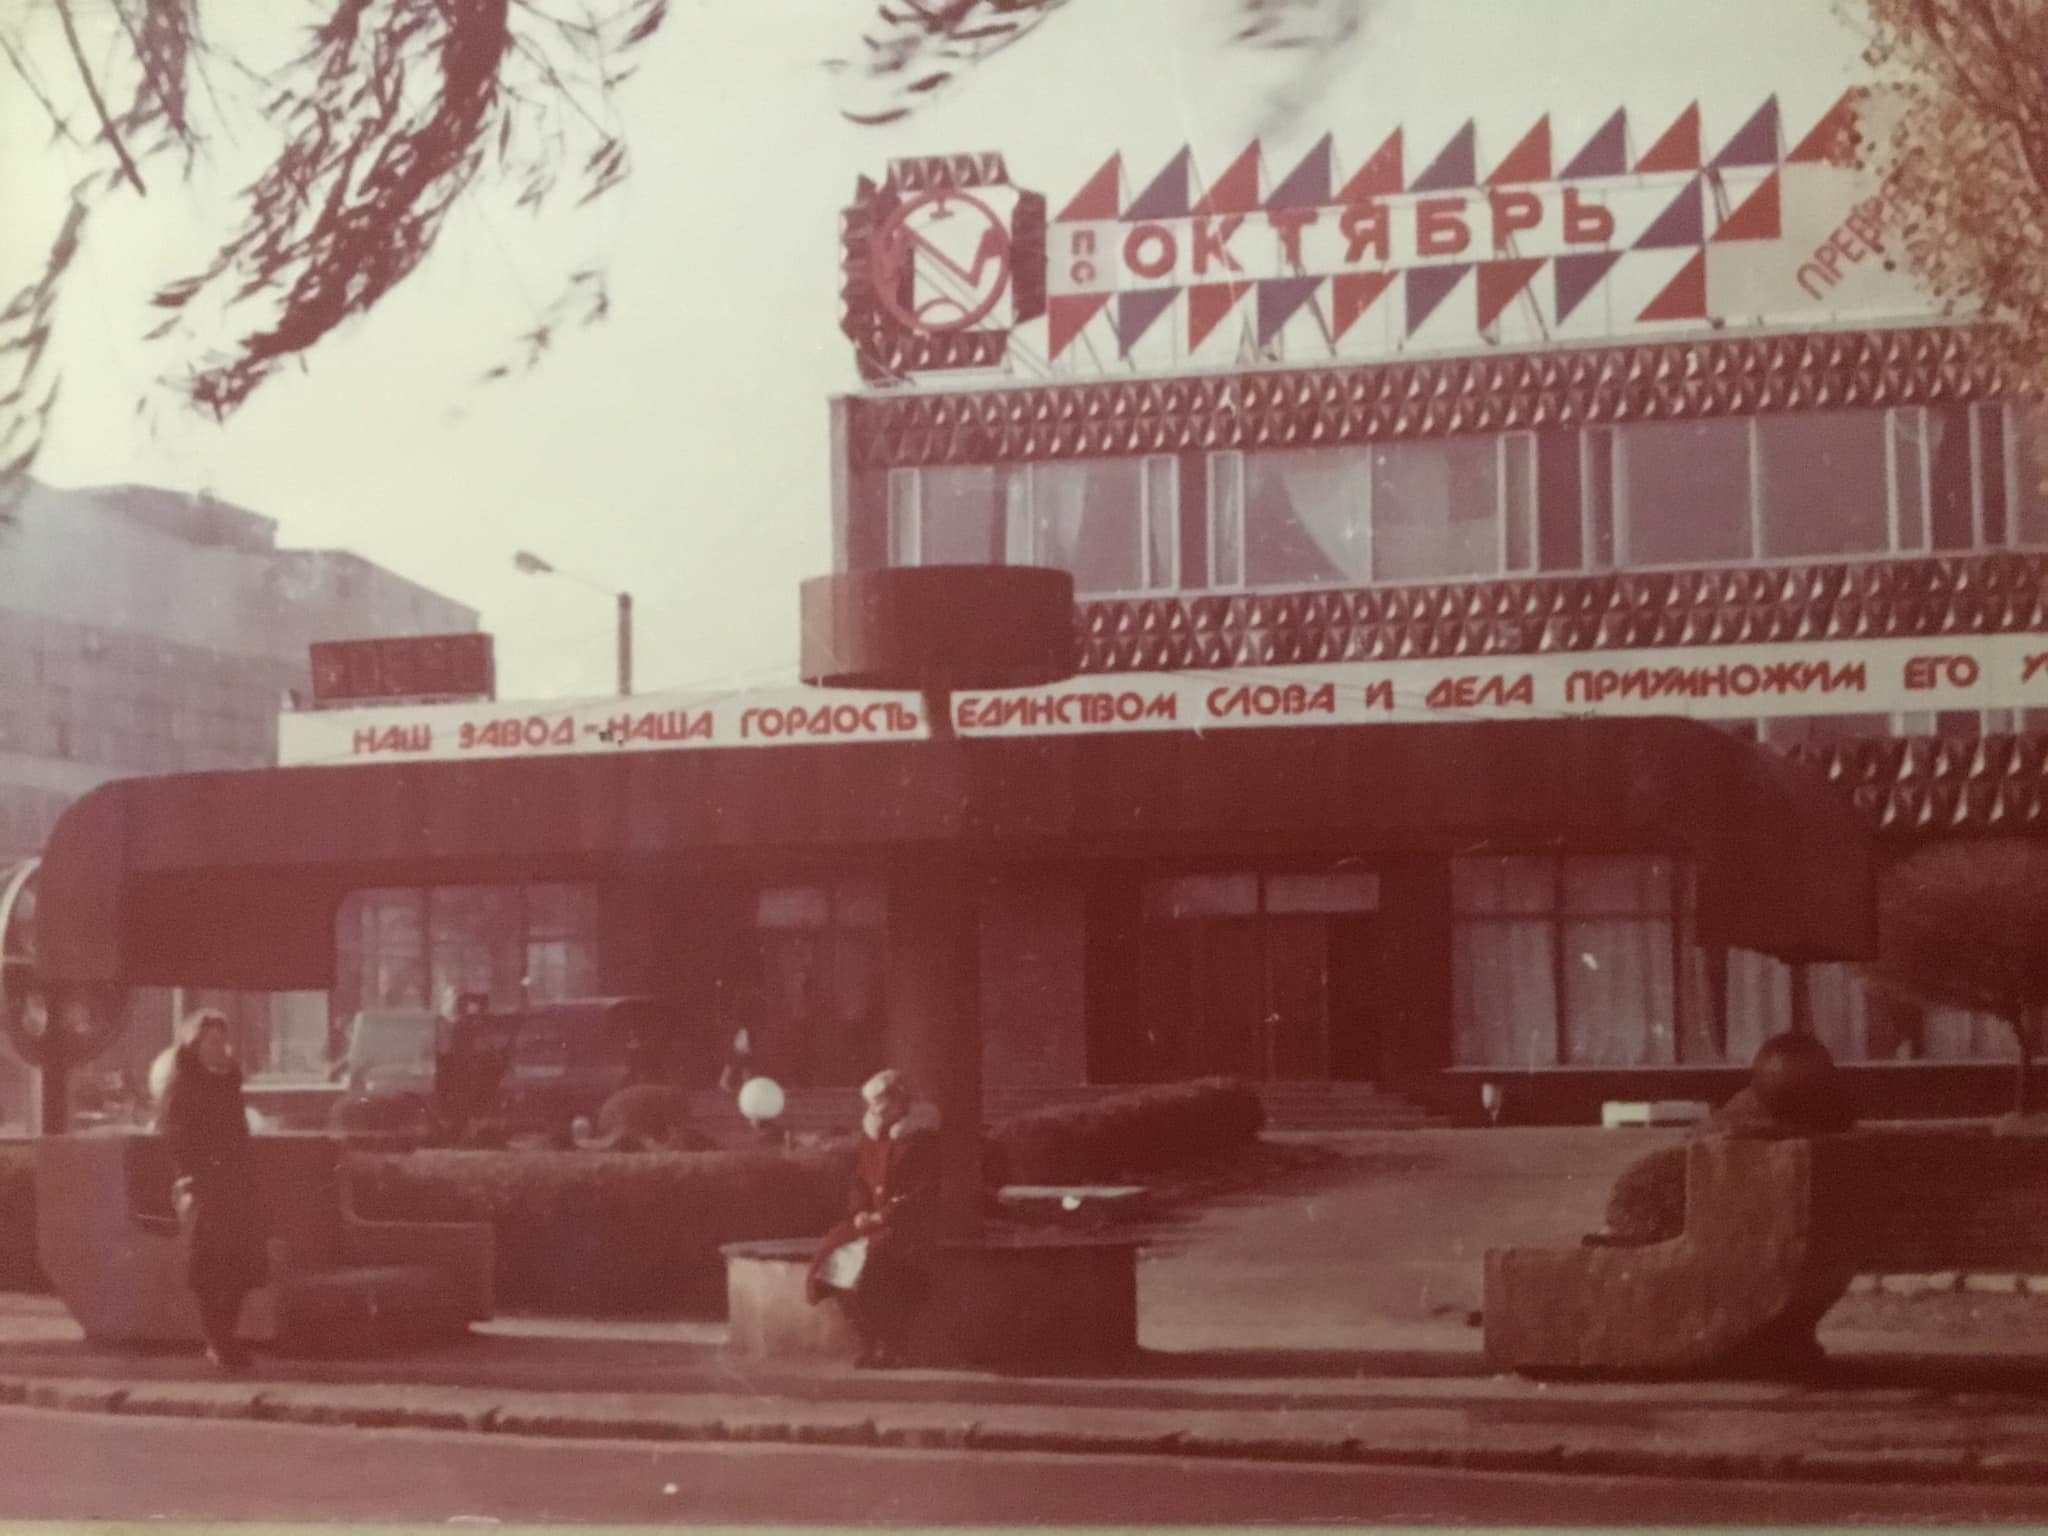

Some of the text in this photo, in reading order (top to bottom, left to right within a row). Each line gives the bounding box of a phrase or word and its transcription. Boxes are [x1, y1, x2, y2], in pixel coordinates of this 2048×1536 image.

[1121, 187, 1615, 280] ОКТЯБРЬ
[353, 725, 431, 755] НАШ
[740, 701, 918, 740] ГОРДОСТЬ
[956, 691, 1178, 730] ЕДИНСТВОМ
[1206, 682, 1336, 719] СЛОВА
[1364, 680, 1395, 711] И
[1424, 672, 1535, 709] ДЕЛА
[1565, 659, 1867, 704] ПРИУМНОЖИМ
[1904, 654, 1979, 691] ЕГО
